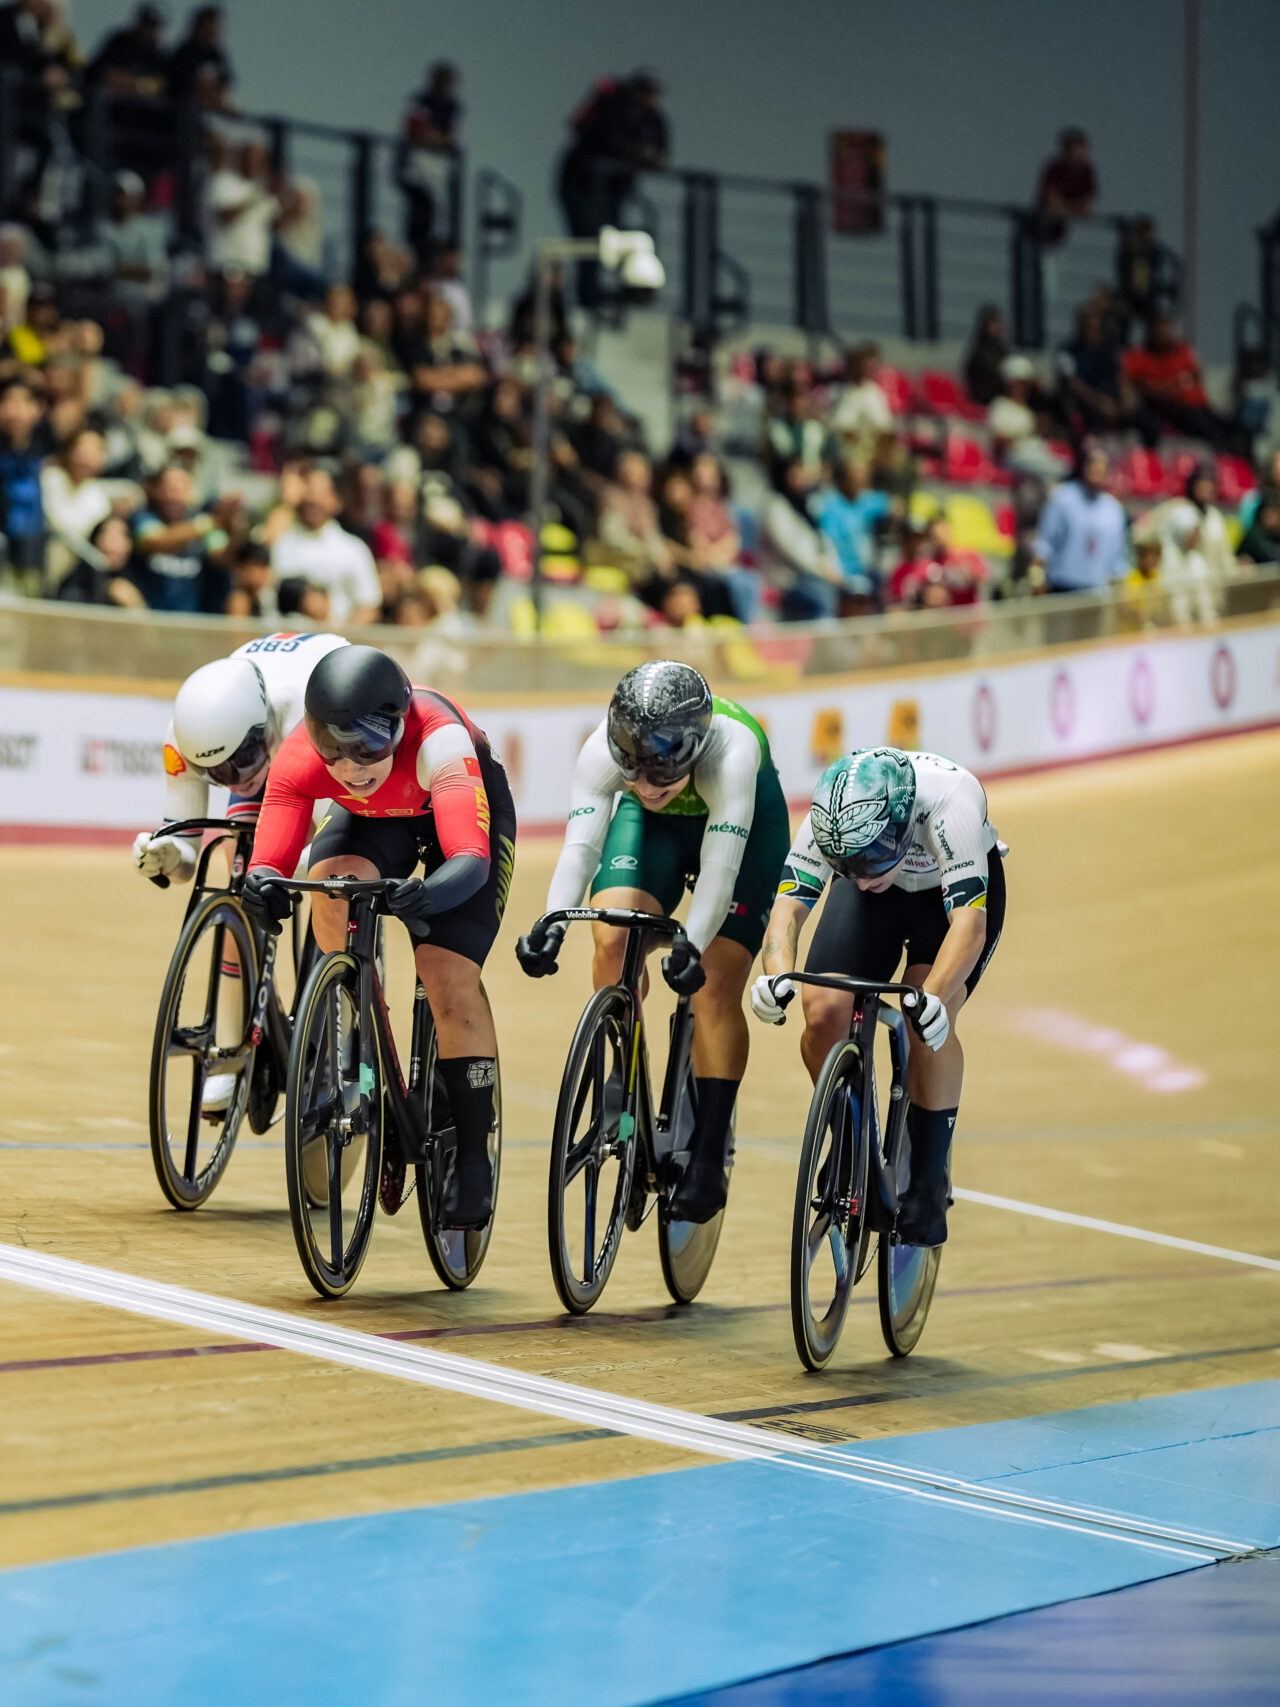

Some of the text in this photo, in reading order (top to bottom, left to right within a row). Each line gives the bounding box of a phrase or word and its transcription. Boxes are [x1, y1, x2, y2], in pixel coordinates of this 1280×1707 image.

[246, 640, 301, 654] GBR
[195, 745, 226, 759] LAZER
[565, 910, 600, 920] Velobike
[253, 937, 277, 1028] LOTU
